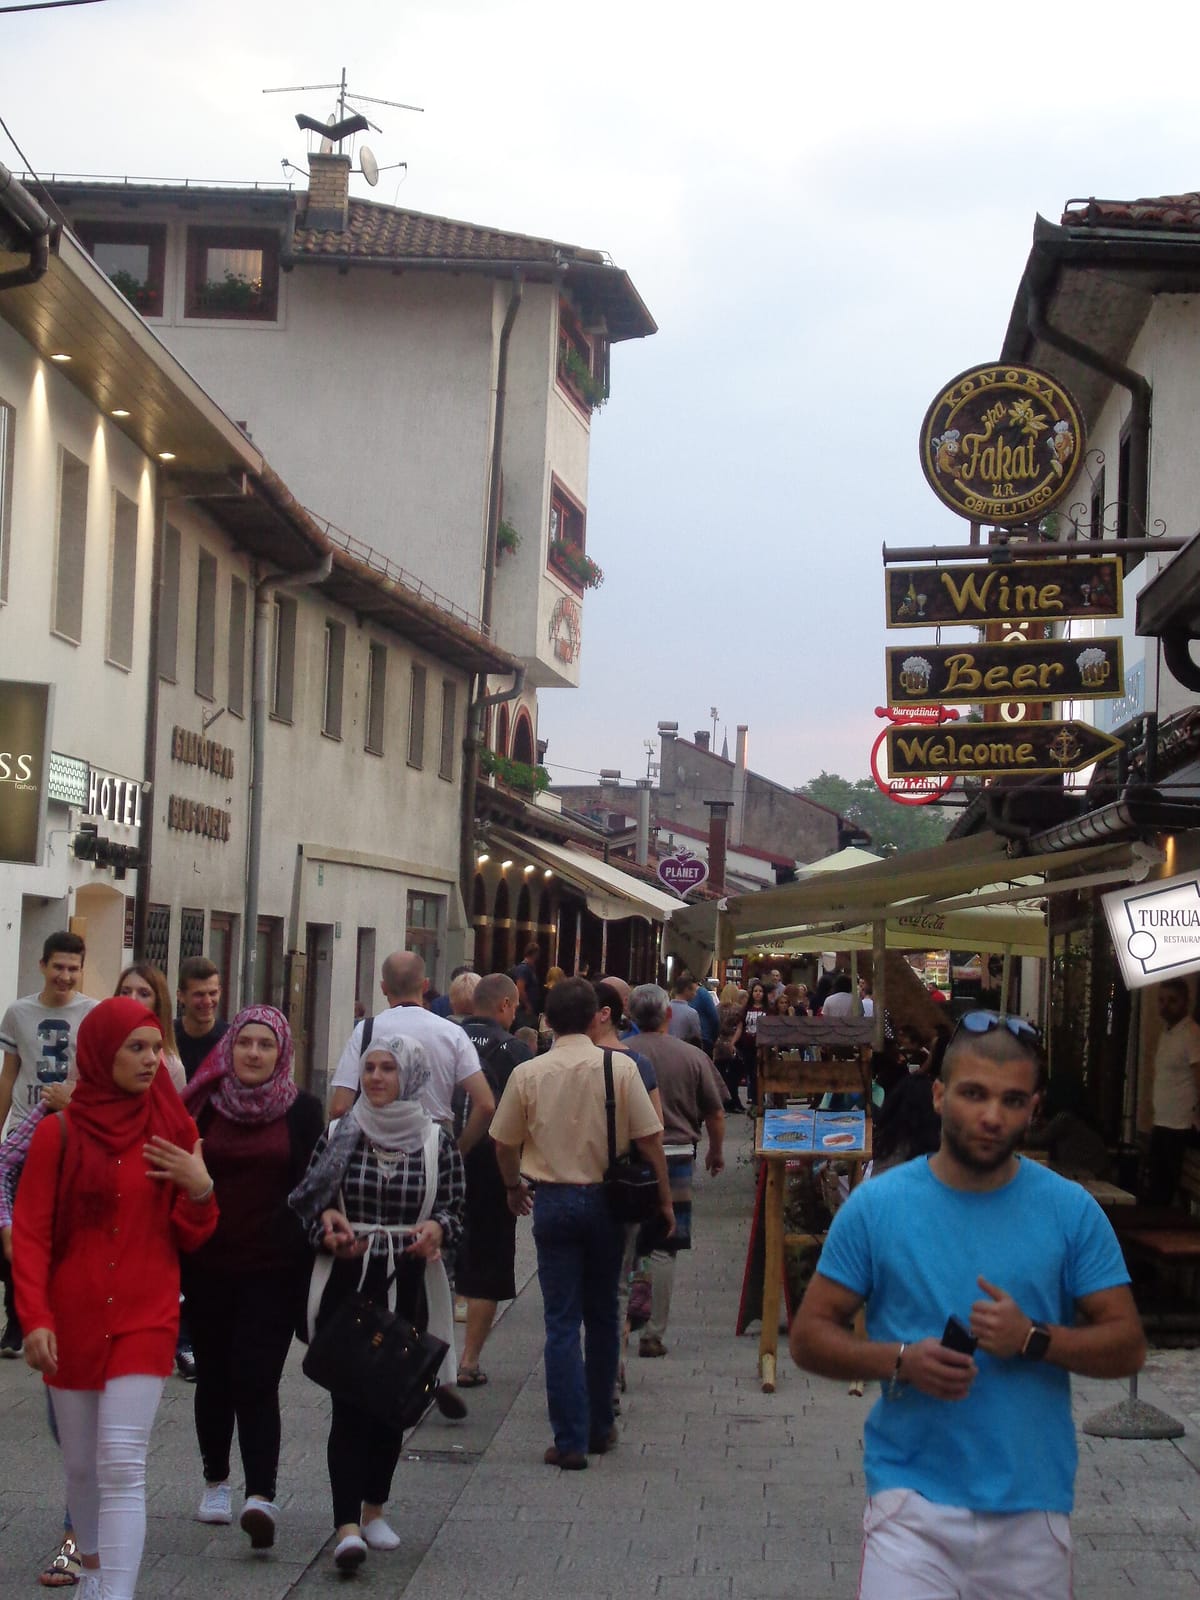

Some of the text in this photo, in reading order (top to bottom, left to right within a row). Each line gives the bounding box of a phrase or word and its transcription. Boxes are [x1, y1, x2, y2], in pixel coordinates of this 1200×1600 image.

[943, 371, 1054, 408] KONOBA
[962, 434, 1040, 480] Fakat
[941, 570, 1063, 613] Wine
[940, 653, 1064, 693] Beer
[897, 735, 1037, 766] Welcome
[14, 782, 38, 791] fashion
[88, 771, 141, 826] HOTEL
[665, 867, 700, 879] PLANET
[37, 1019, 71, 1083] 3
